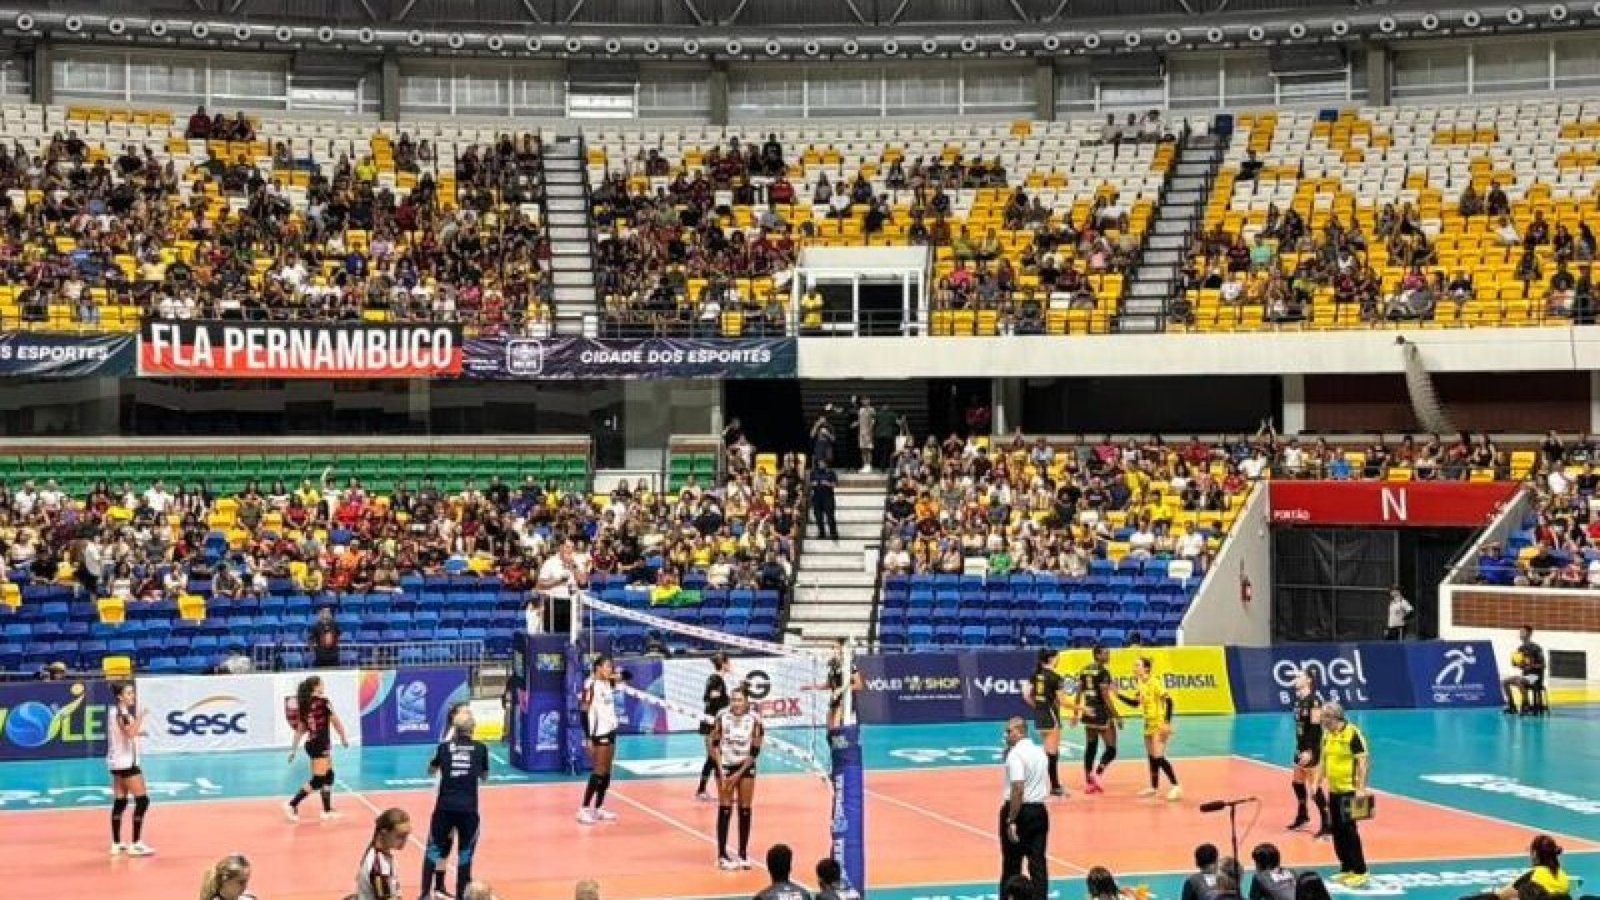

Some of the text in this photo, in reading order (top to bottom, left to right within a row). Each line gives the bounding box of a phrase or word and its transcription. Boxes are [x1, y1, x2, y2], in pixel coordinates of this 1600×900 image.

[17, 345, 109, 361] ESPORTES
[151, 323, 452, 369] FLA PERNAMBUCO
[580, 349, 771, 364] CIDADE DOS ESPORTES
[1380, 487, 1408, 521] N
[1273, 649, 1367, 687] enel
[925, 677, 961, 691] SHOP
[1162, 673, 1218, 690] BRASIL
